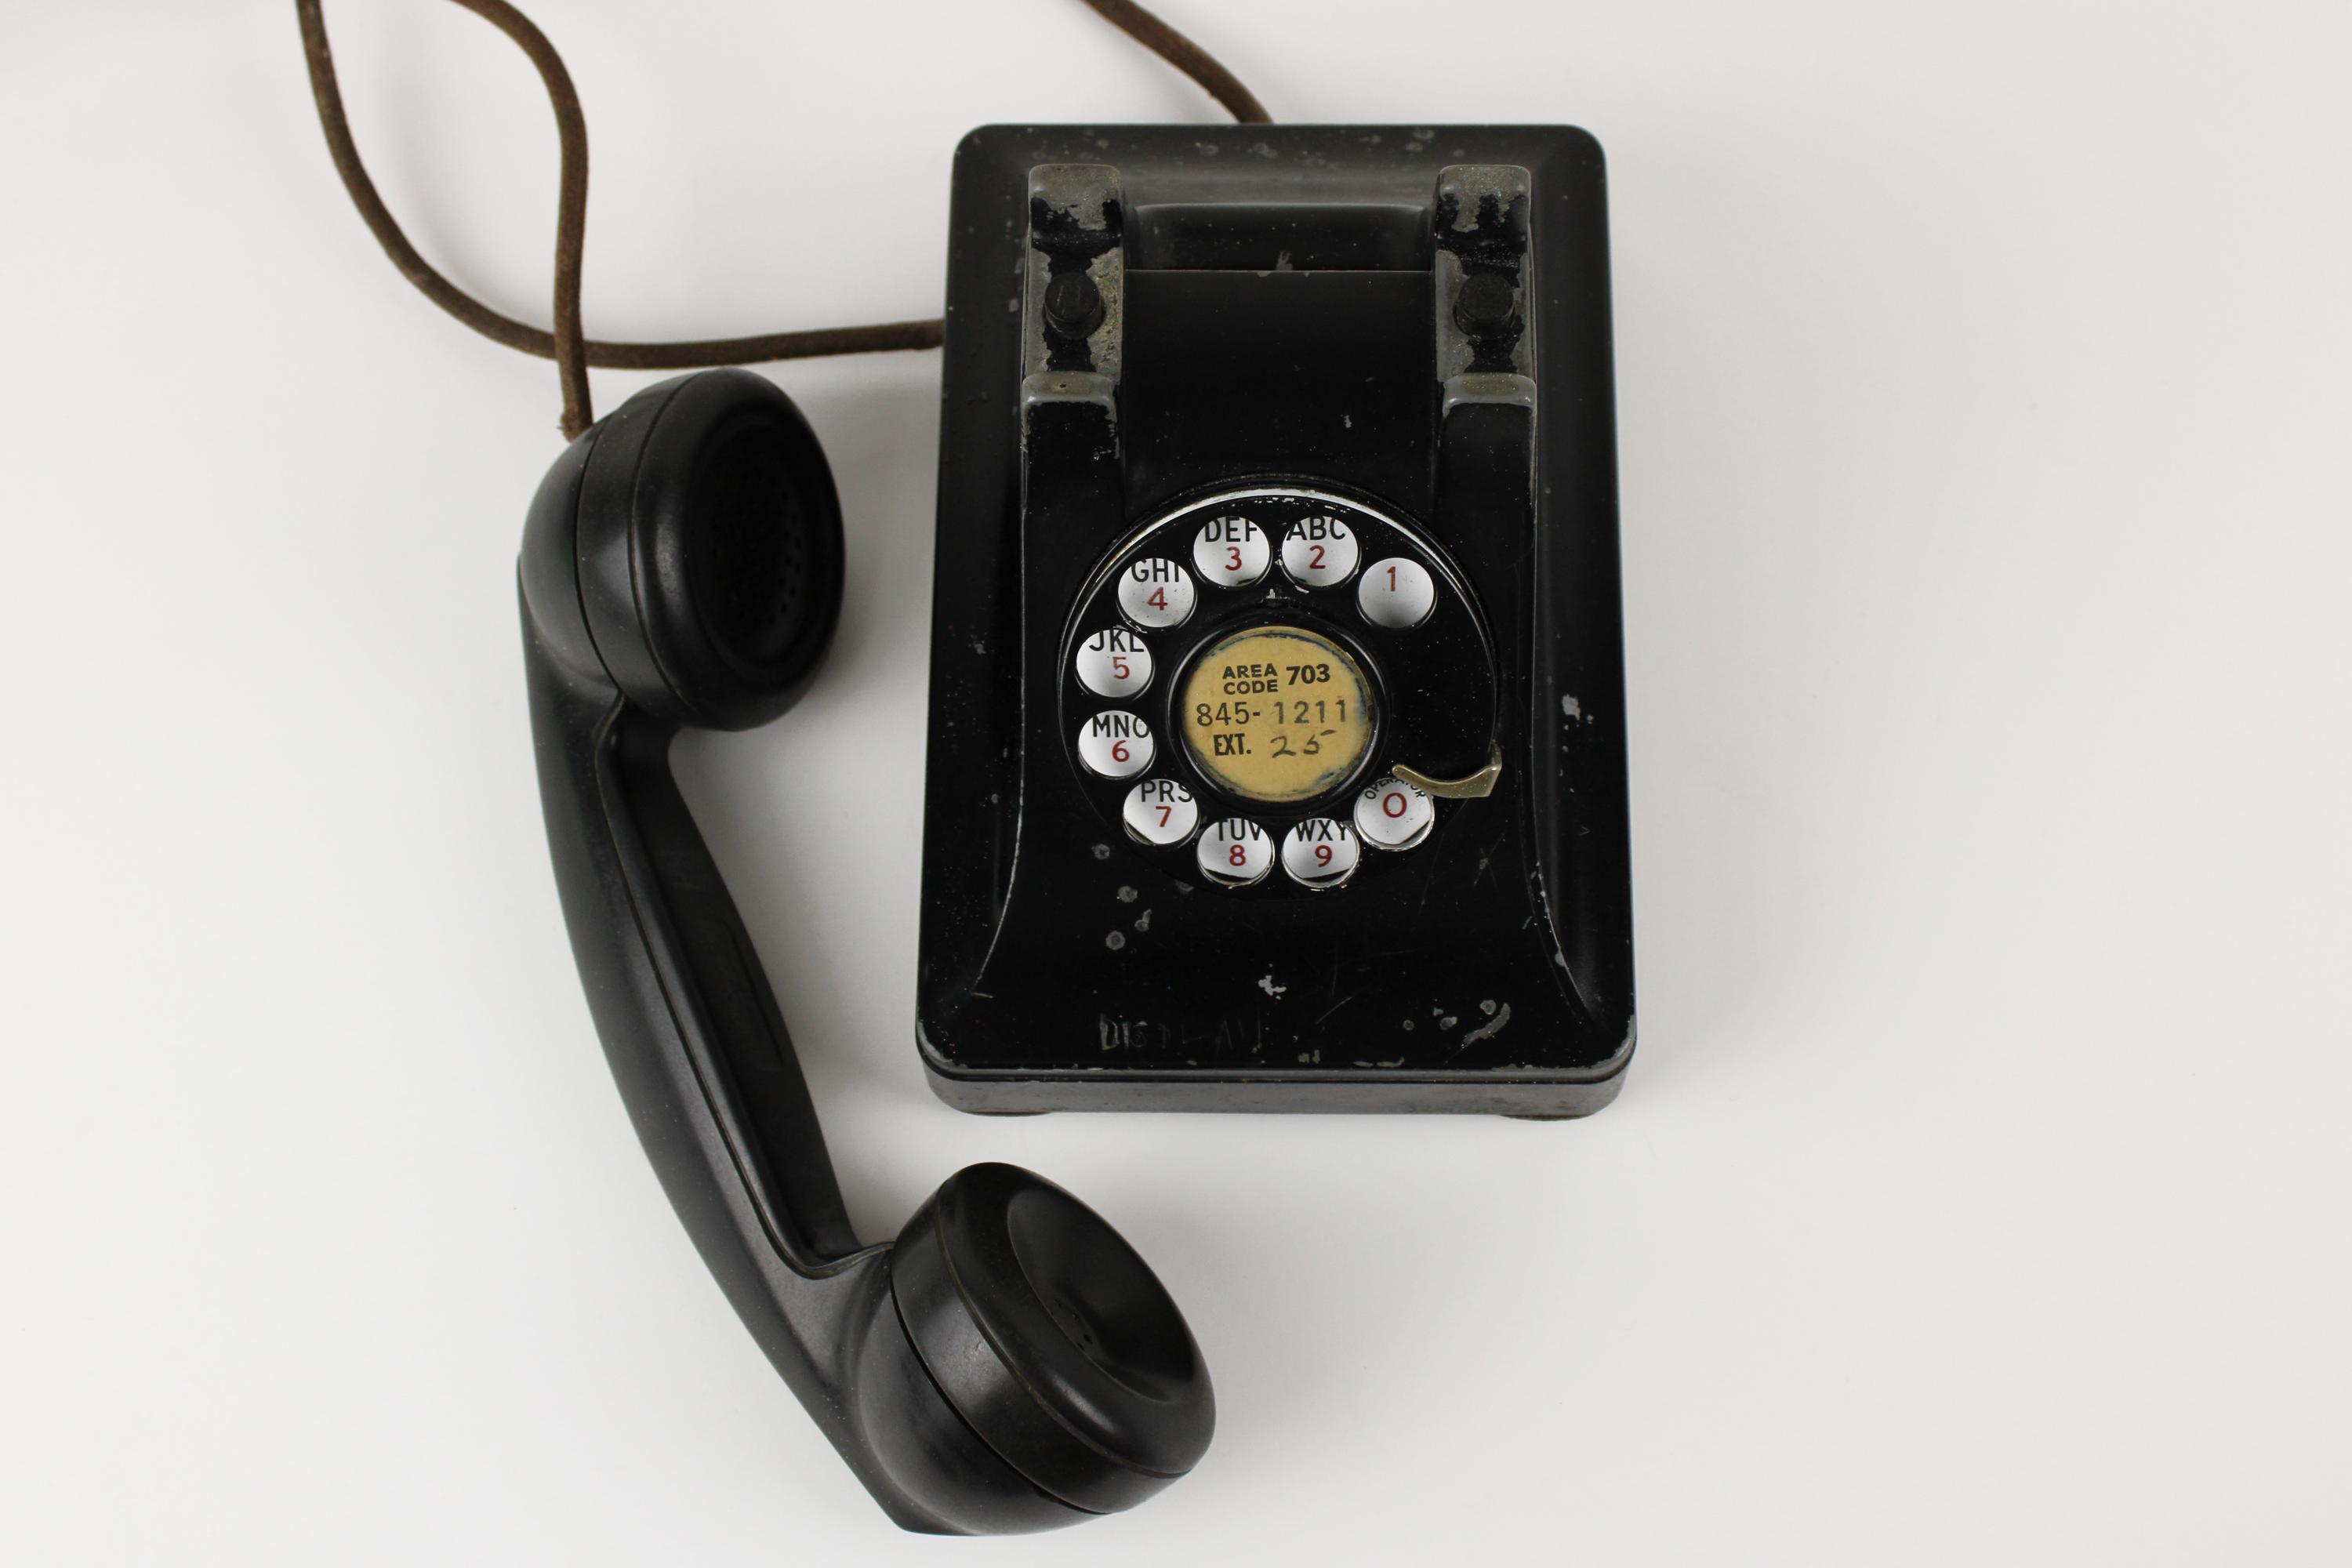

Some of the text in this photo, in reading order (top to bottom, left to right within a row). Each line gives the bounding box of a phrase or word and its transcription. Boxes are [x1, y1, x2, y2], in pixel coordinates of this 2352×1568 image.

[1205, 516, 1257, 542] DEF
[1287, 516, 1345, 540] ABC
[1225, 546, 1242, 571] 3
[1309, 545, 1326, 569] 2
[1131, 558, 1179, 583] GHI
[1387, 566, 1396, 592] 1
[1147, 586, 1167, 611] 4
[1089, 629, 1144, 652] JKL
[1112, 656, 1130, 680] 5
[1222, 663, 1278, 680] AREA
[1287, 664, 1330, 685] 703
[1223, 680, 1279, 695] CODE
[1092, 714, 1150, 738] MNO
[1112, 740, 1130, 762] 6
[1213, 733, 1252, 756] EXT.
[1141, 780, 1193, 802] PRS
[1364, 778, 1426, 800] OPEOR
[1156, 806, 1171, 827] 7
[1216, 819, 1261, 841] TUV
[1295, 819, 1346, 841] WXY
[1229, 844, 1246, 866] 8
[1315, 844, 1332, 867] 9
